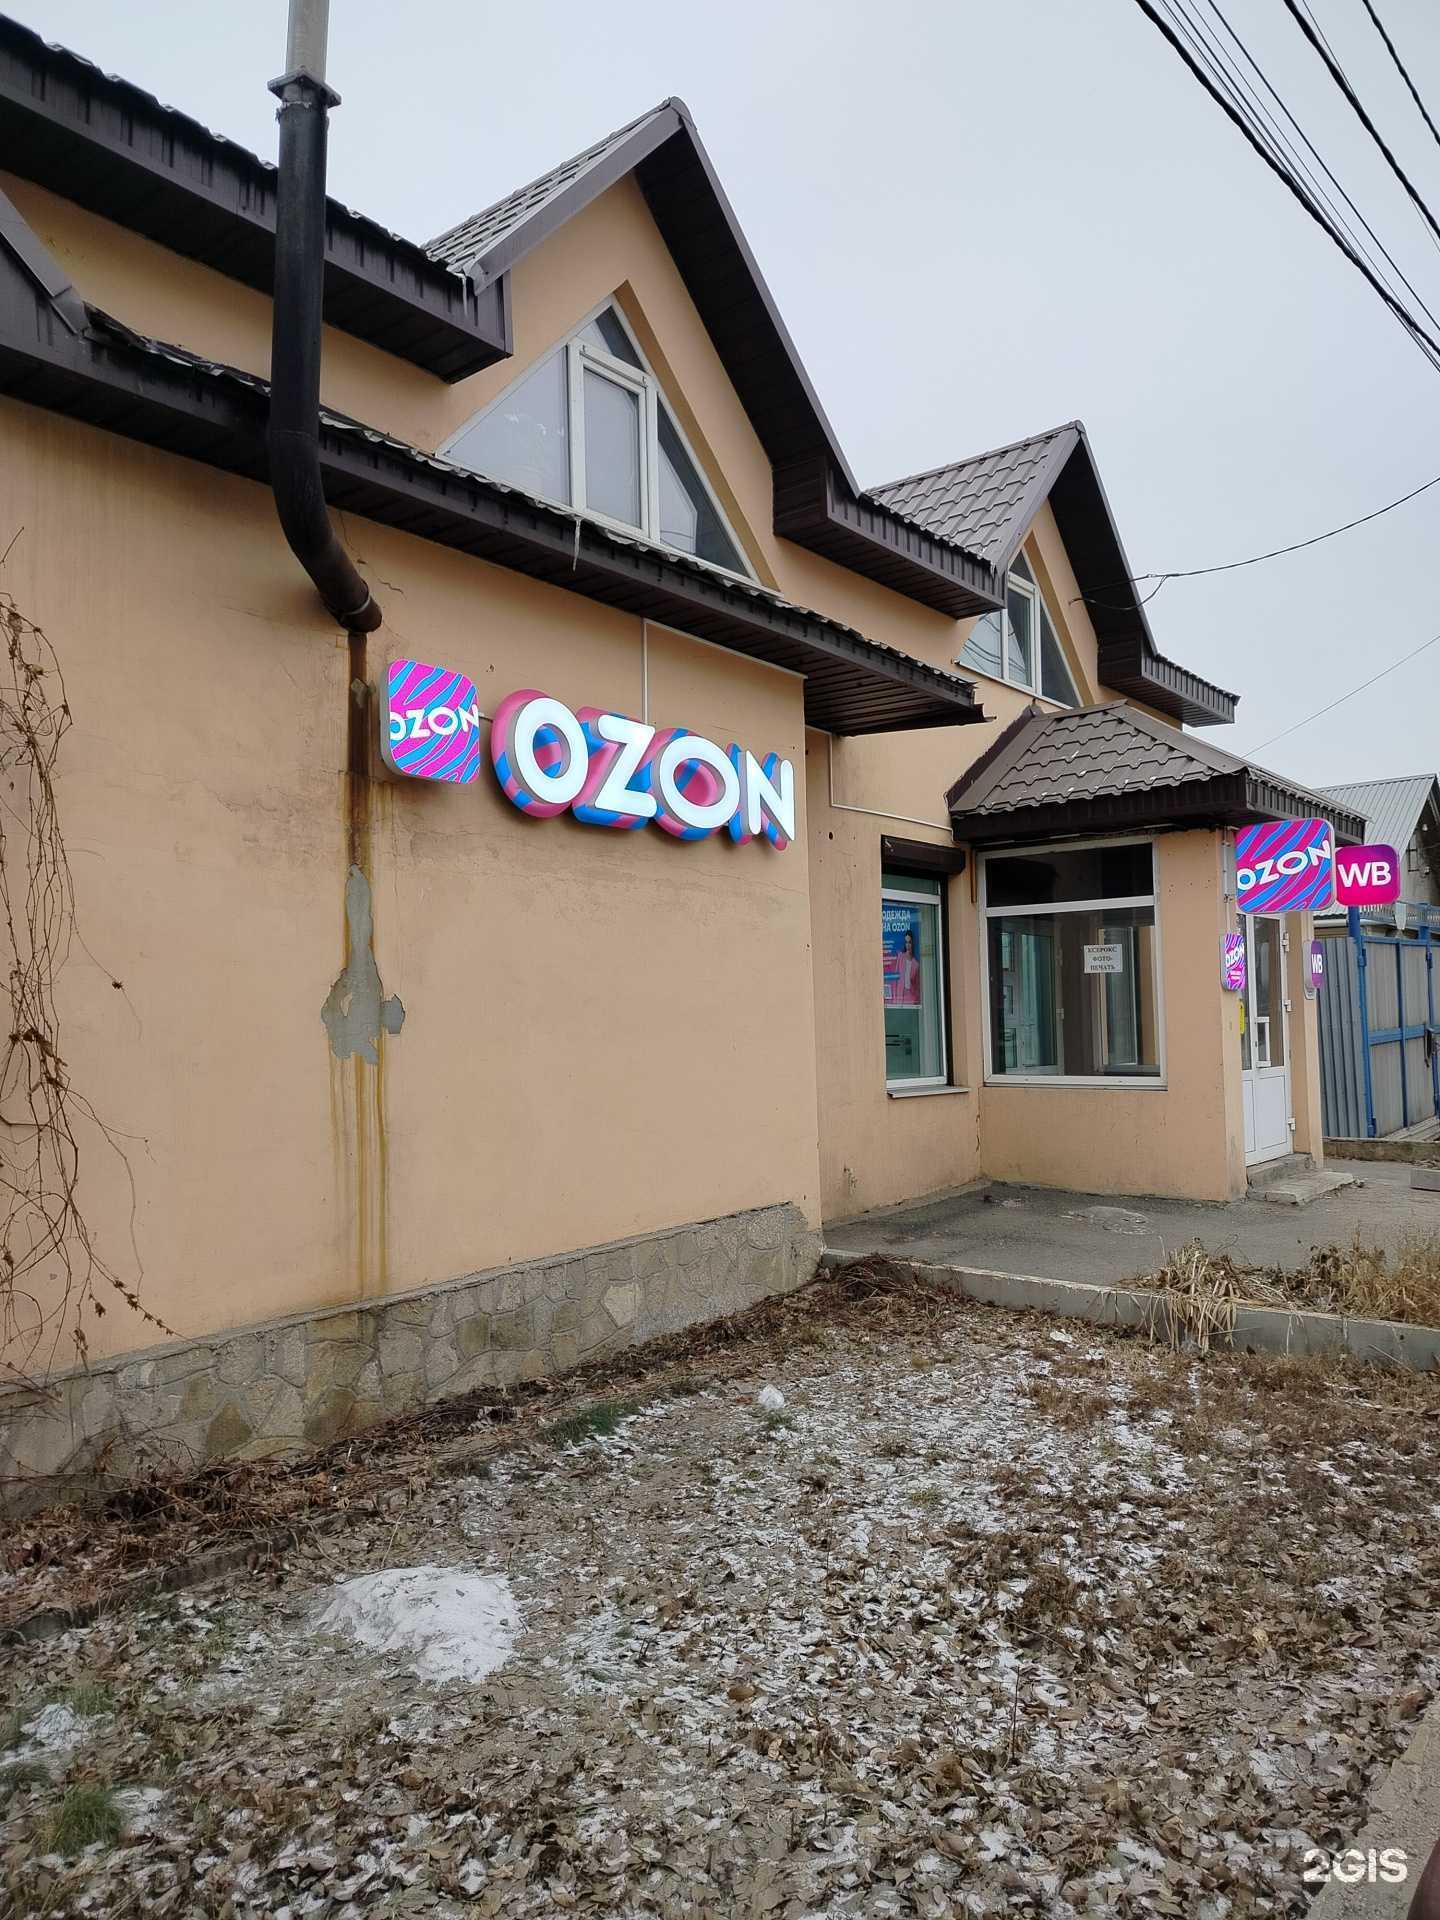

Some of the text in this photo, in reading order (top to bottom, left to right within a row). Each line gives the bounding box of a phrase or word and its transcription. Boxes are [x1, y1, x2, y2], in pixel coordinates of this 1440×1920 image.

[389, 704, 479, 741] OZON
[514, 697, 796, 842] OZON
[1237, 840, 1331, 891] OZON
[1337, 861, 1392, 888] WB
[1226, 943, 1245, 968] OZON
[1311, 953, 1323, 974] WB
